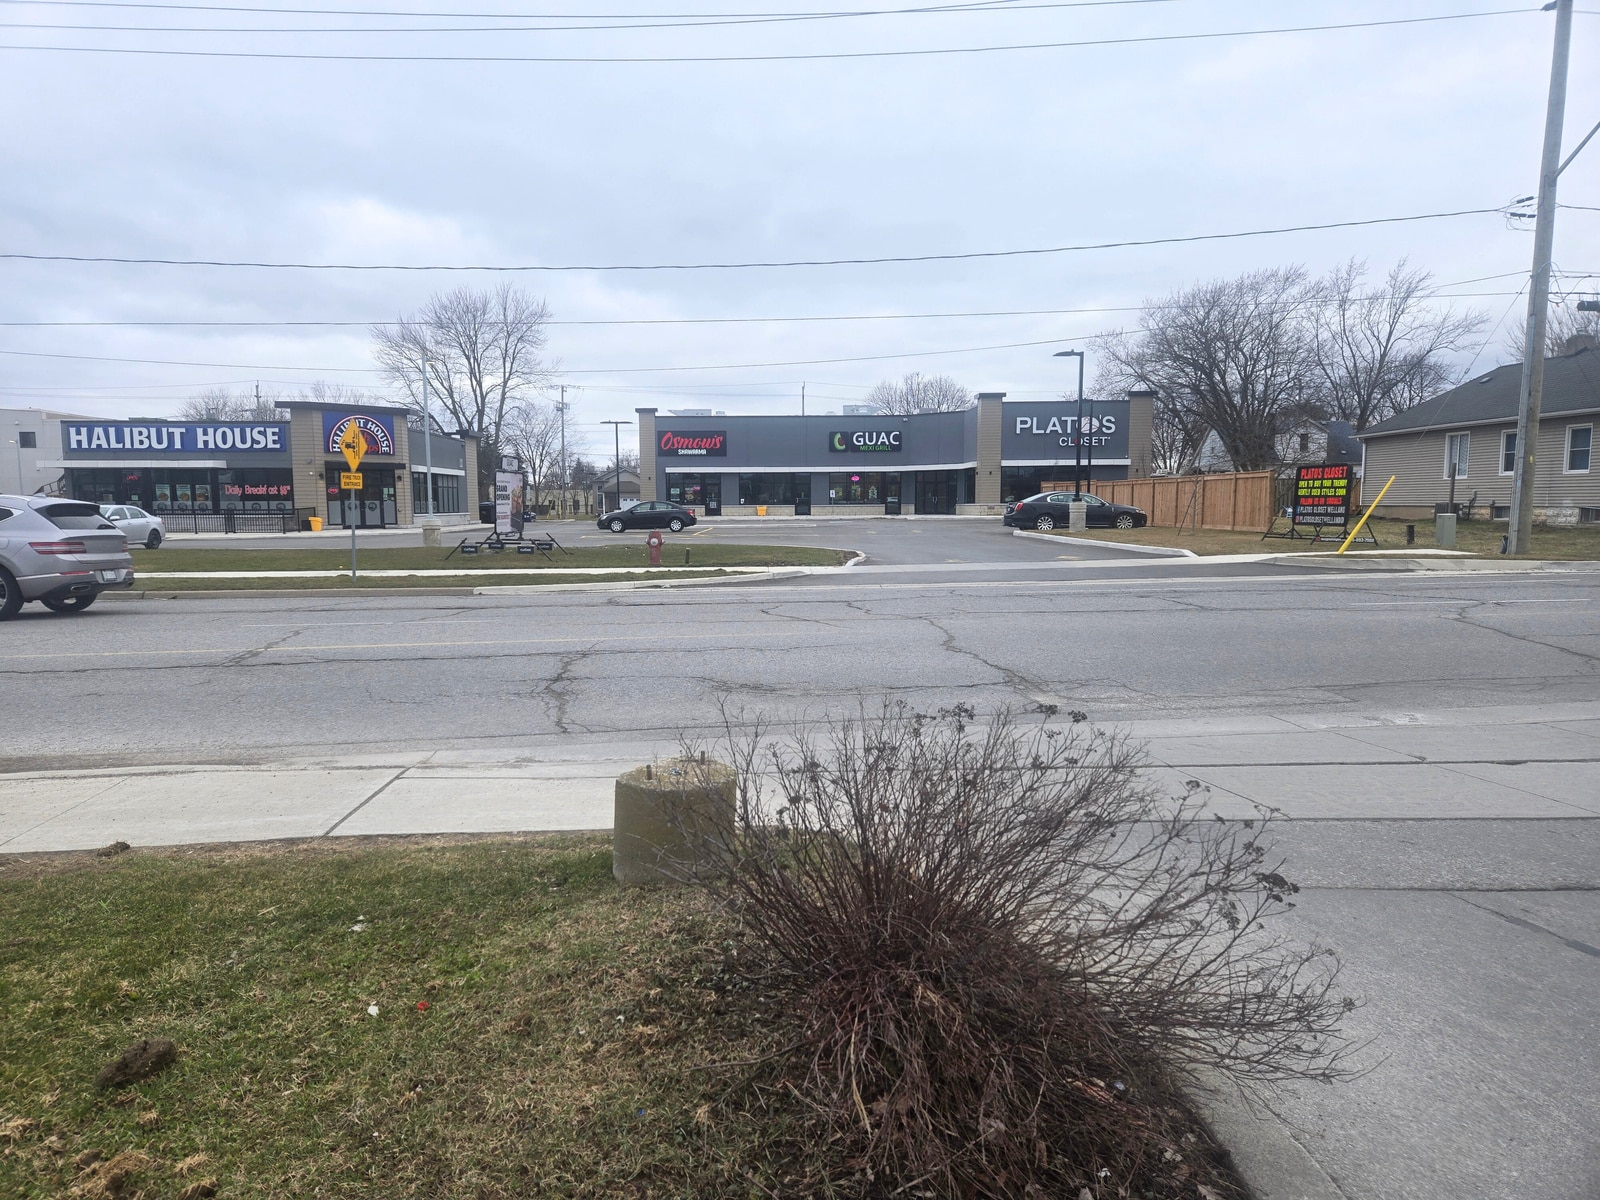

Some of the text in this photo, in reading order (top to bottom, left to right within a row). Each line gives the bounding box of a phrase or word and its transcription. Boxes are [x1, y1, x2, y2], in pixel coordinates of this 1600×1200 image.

[69, 427, 281, 449] HALIBUT HOUSE
[367, 422, 390, 452] HOUSE
[852, 431, 900, 446] GUAC
[1301, 466, 1347, 479] PLATOS CLOSET
[224, 484, 243, 496] Daily
